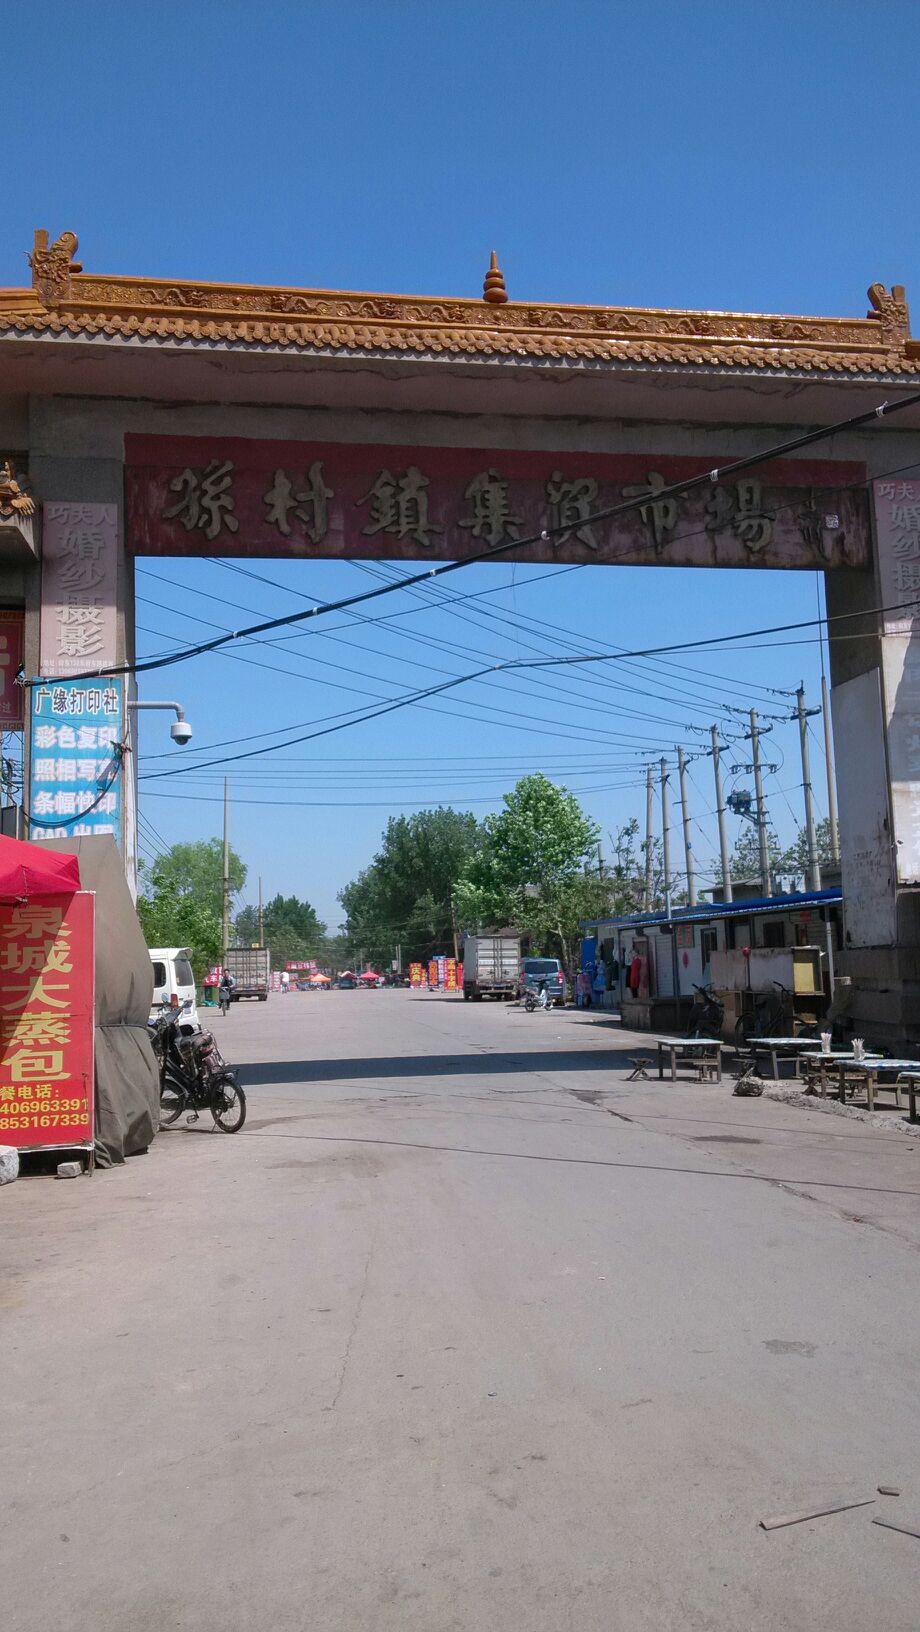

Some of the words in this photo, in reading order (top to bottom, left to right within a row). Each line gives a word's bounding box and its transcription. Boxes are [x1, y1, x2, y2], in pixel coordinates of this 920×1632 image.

[878, 482, 920, 501] 巧夫
[48, 505, 116, 526] 巧夫人
[55, 528, 105, 658] 婚纱摄影
[35, 687, 119, 715] 广缘打印社
[34, 725, 118, 749] 彩色复印
[33, 790, 117, 815] 条幅快印
[1, 904, 73, 1082] 泉城大蒸包
[0, 1098, 89, 1114] 406963391
[0, 1113, 90, 1130] 853167339
